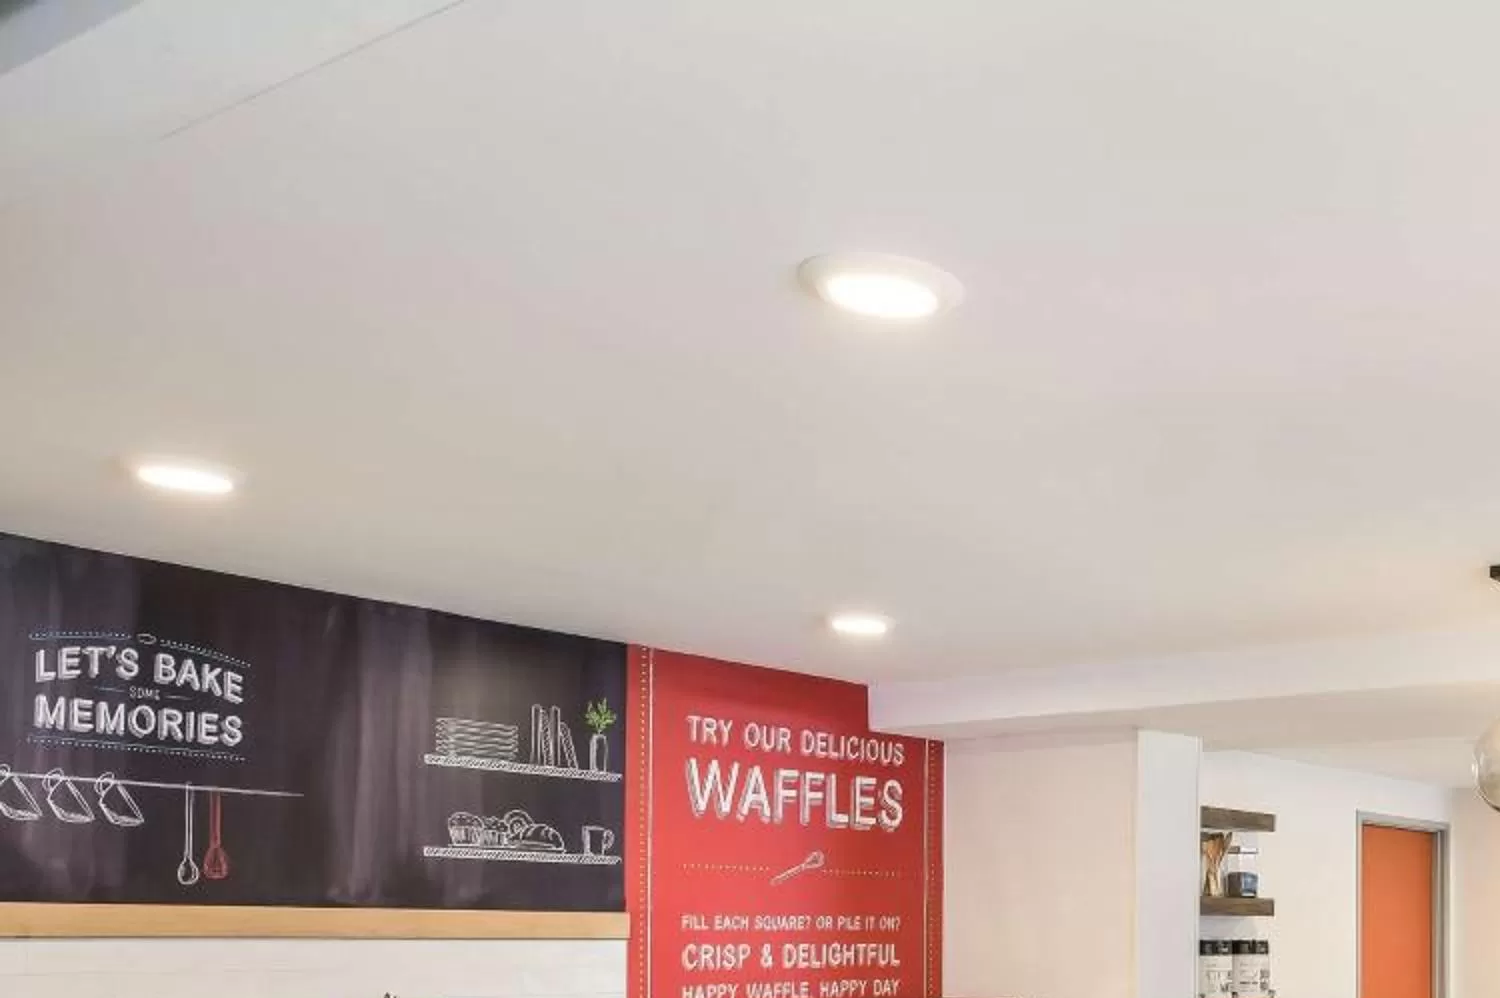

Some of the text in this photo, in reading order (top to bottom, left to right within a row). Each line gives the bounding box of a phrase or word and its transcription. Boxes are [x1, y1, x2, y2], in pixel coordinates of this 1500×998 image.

[34, 645, 244, 704] LET'S BAKE
[129, 685, 161, 700] SOME
[33, 693, 244, 747] MEMORIES
[686, 715, 905, 767] TRY OUR DELICIOUS
[685, 756, 904, 833] WAFFLES
[681, 914, 710, 930] FILL
[714, 915, 749, 931] EACH
[754, 915, 811, 932] SQUARE?
[815, 915, 833, 931] OR
[837, 915, 861, 931] PILE
[865, 916, 876, 932] IT
[681, 942, 901, 970] CRISP & DELIGHTFUL
[819, 979, 868, 998] HAPPY
[873, 978, 901, 996] DAY
